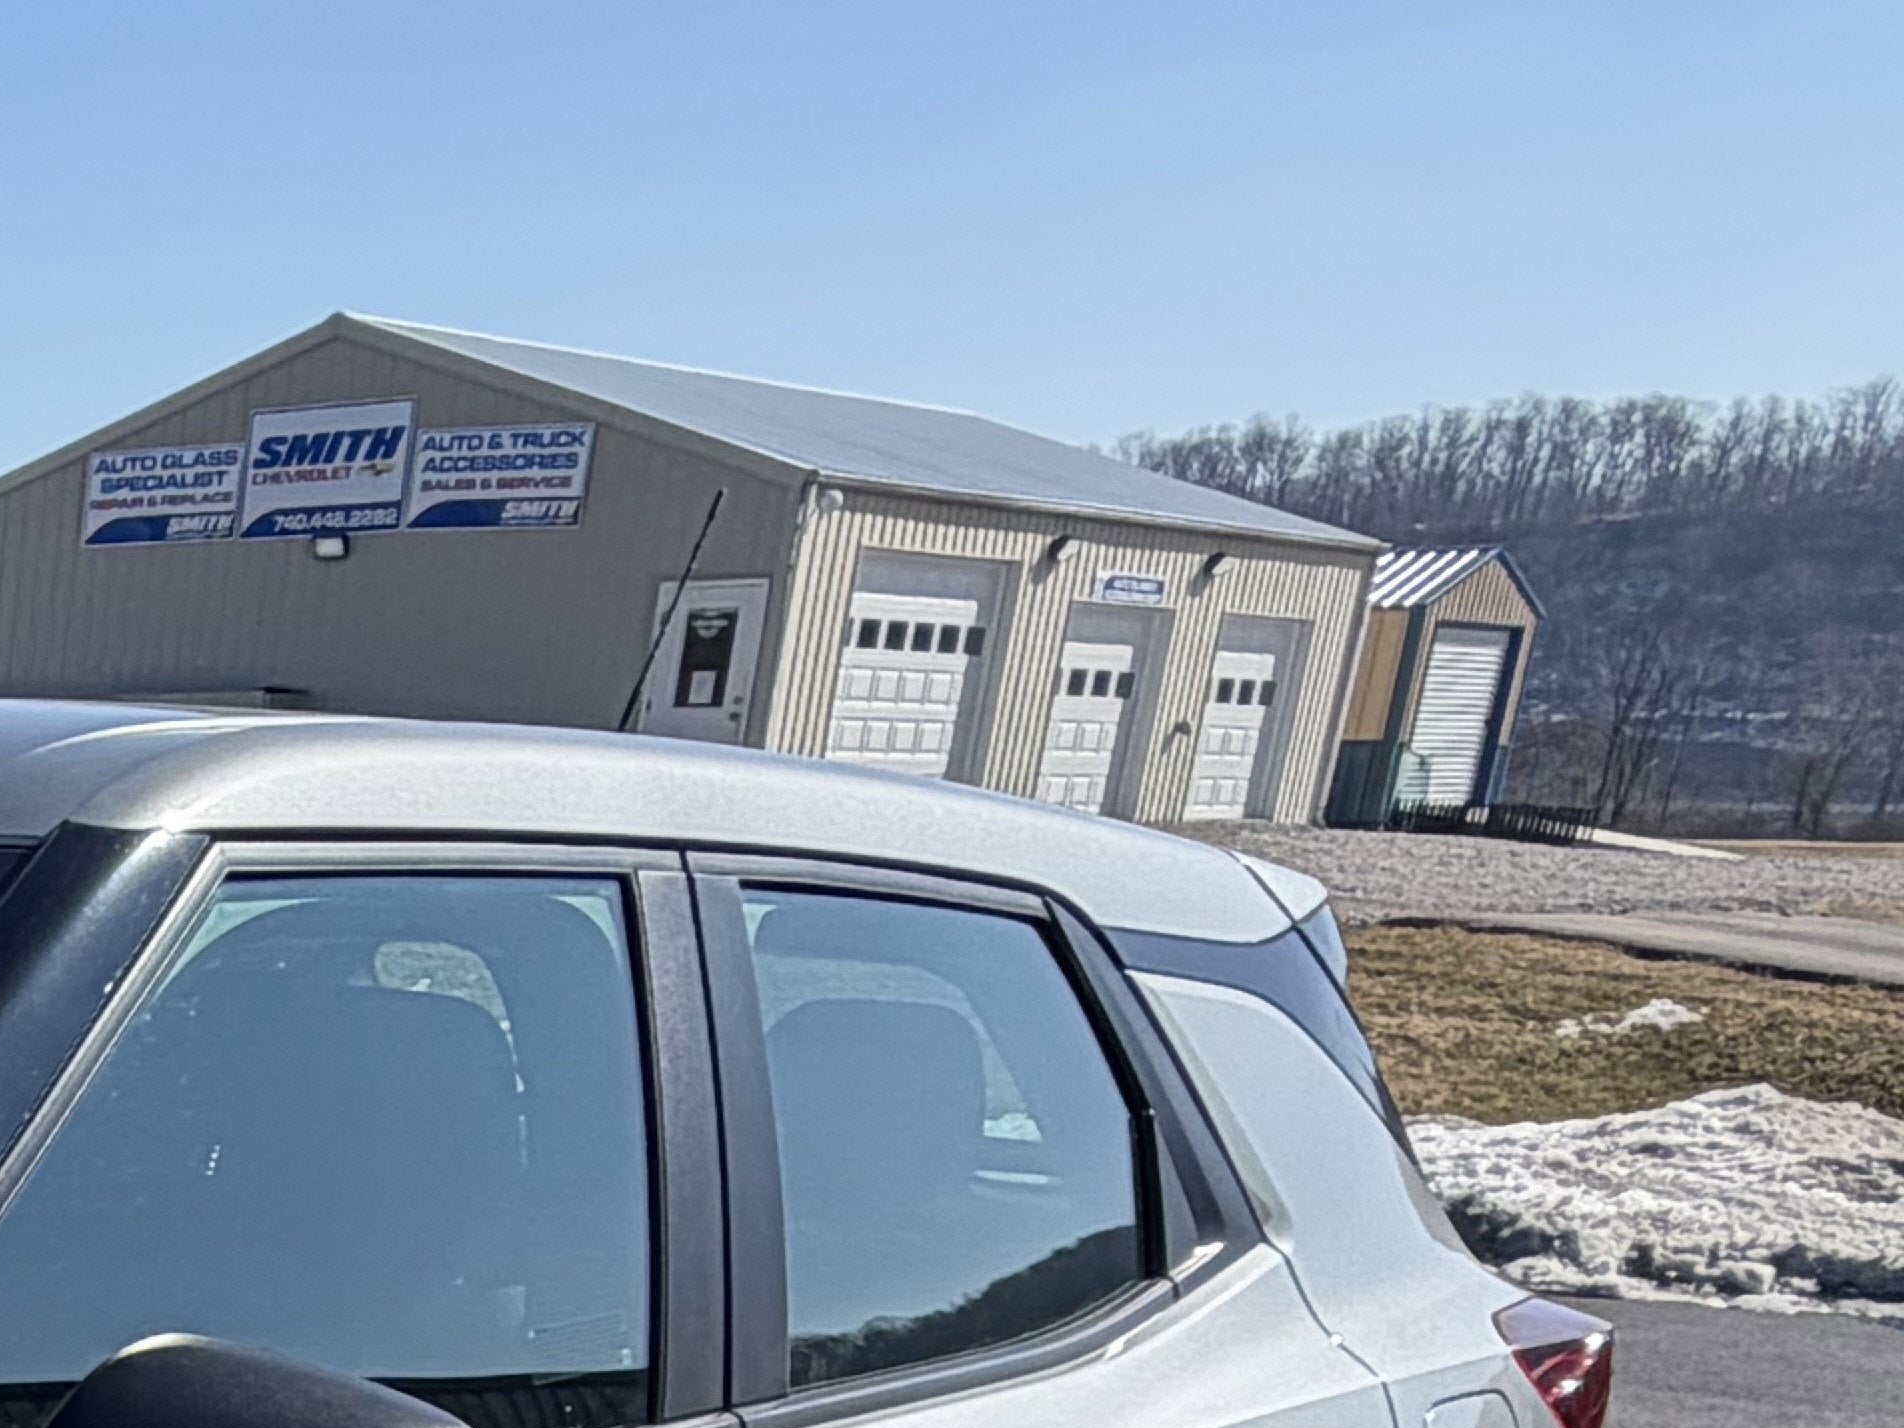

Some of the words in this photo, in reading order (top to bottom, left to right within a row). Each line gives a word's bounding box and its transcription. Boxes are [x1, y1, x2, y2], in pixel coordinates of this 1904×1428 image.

[252, 425, 406, 470] SMITH
[422, 435, 484, 451] AUTO
[488, 433, 503, 449] &
[509, 430, 585, 447] TRUCK
[95, 456, 157, 473] AUTO
[160, 450, 239, 469] GLASS
[421, 453, 578, 473] ACCESSORIES
[100, 471, 228, 494] SPECIALIST
[252, 467, 352, 486] CHEVROLET
